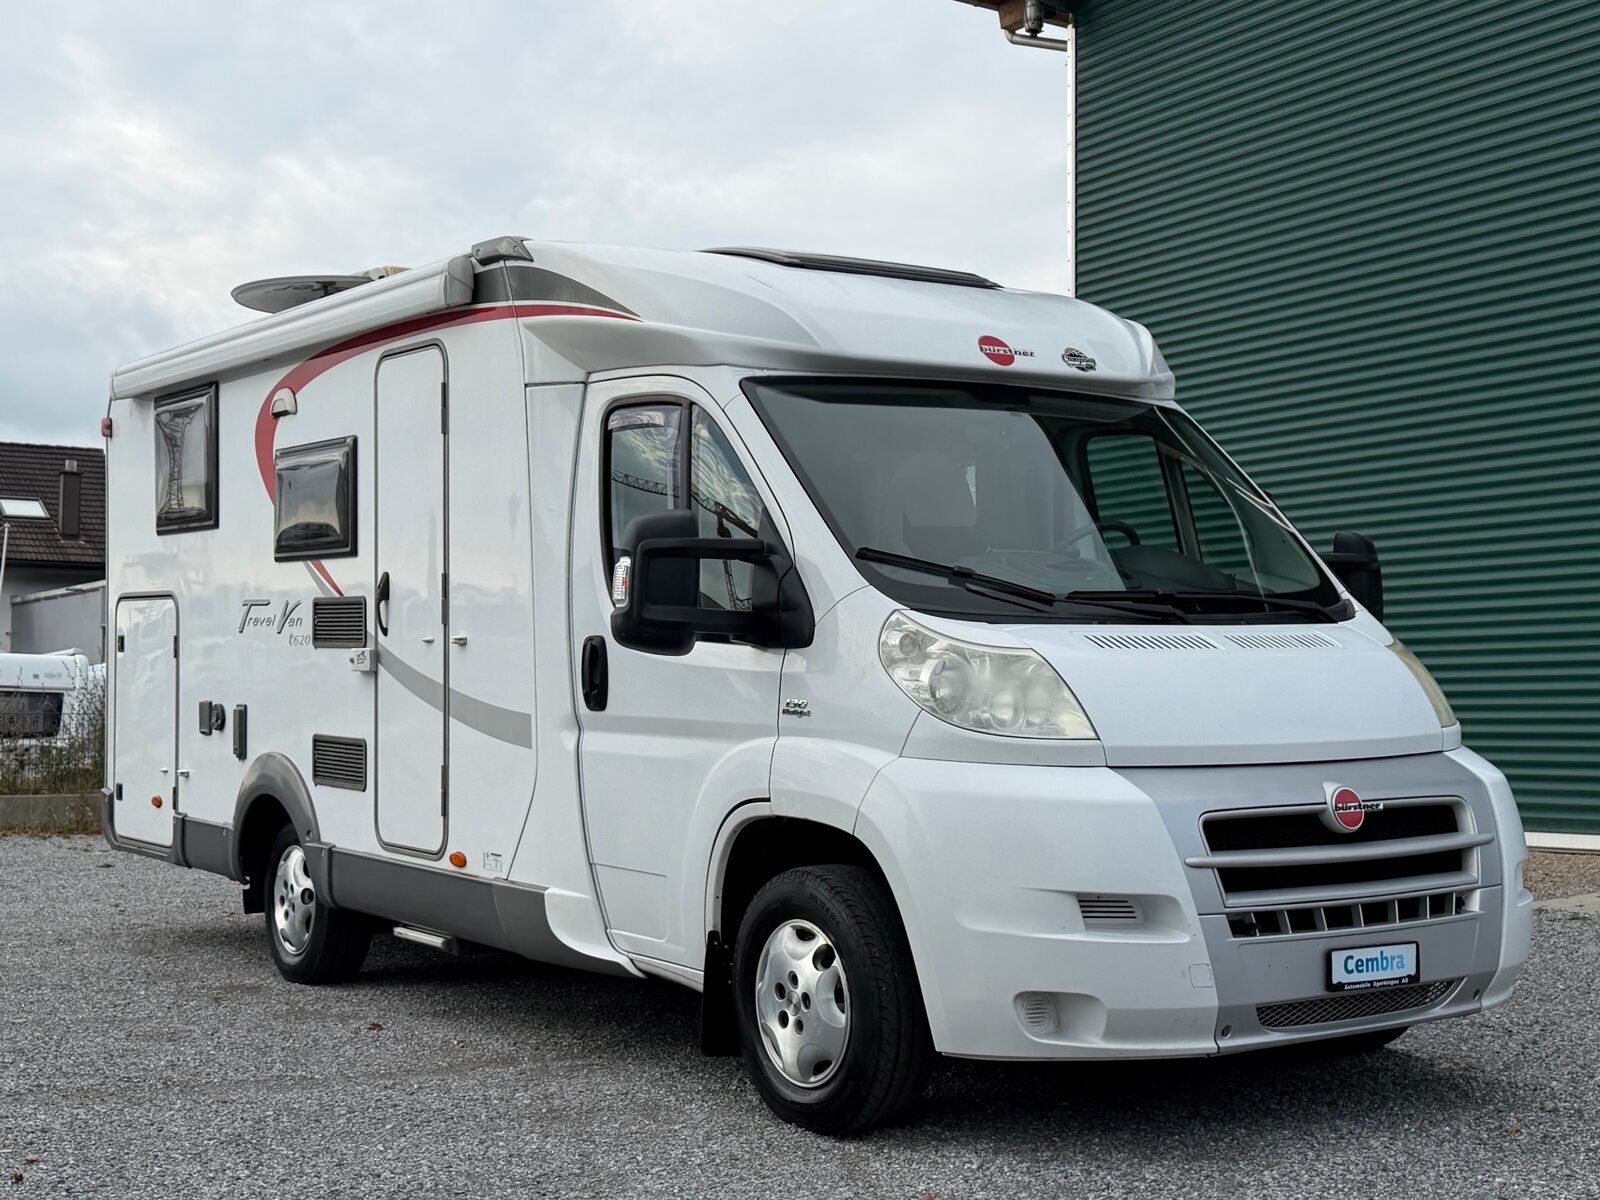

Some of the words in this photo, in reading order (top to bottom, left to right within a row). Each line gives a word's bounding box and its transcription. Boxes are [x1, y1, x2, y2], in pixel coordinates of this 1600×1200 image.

[979, 344, 1036, 358] bürstner
[238, 599, 277, 634] Travel
[277, 599, 303, 634] Van
[288, 632, 311, 646] t620
[785, 698, 809, 709] 130
[1334, 801, 1383, 812] bürstner
[1343, 950, 1405, 975] Cembra
